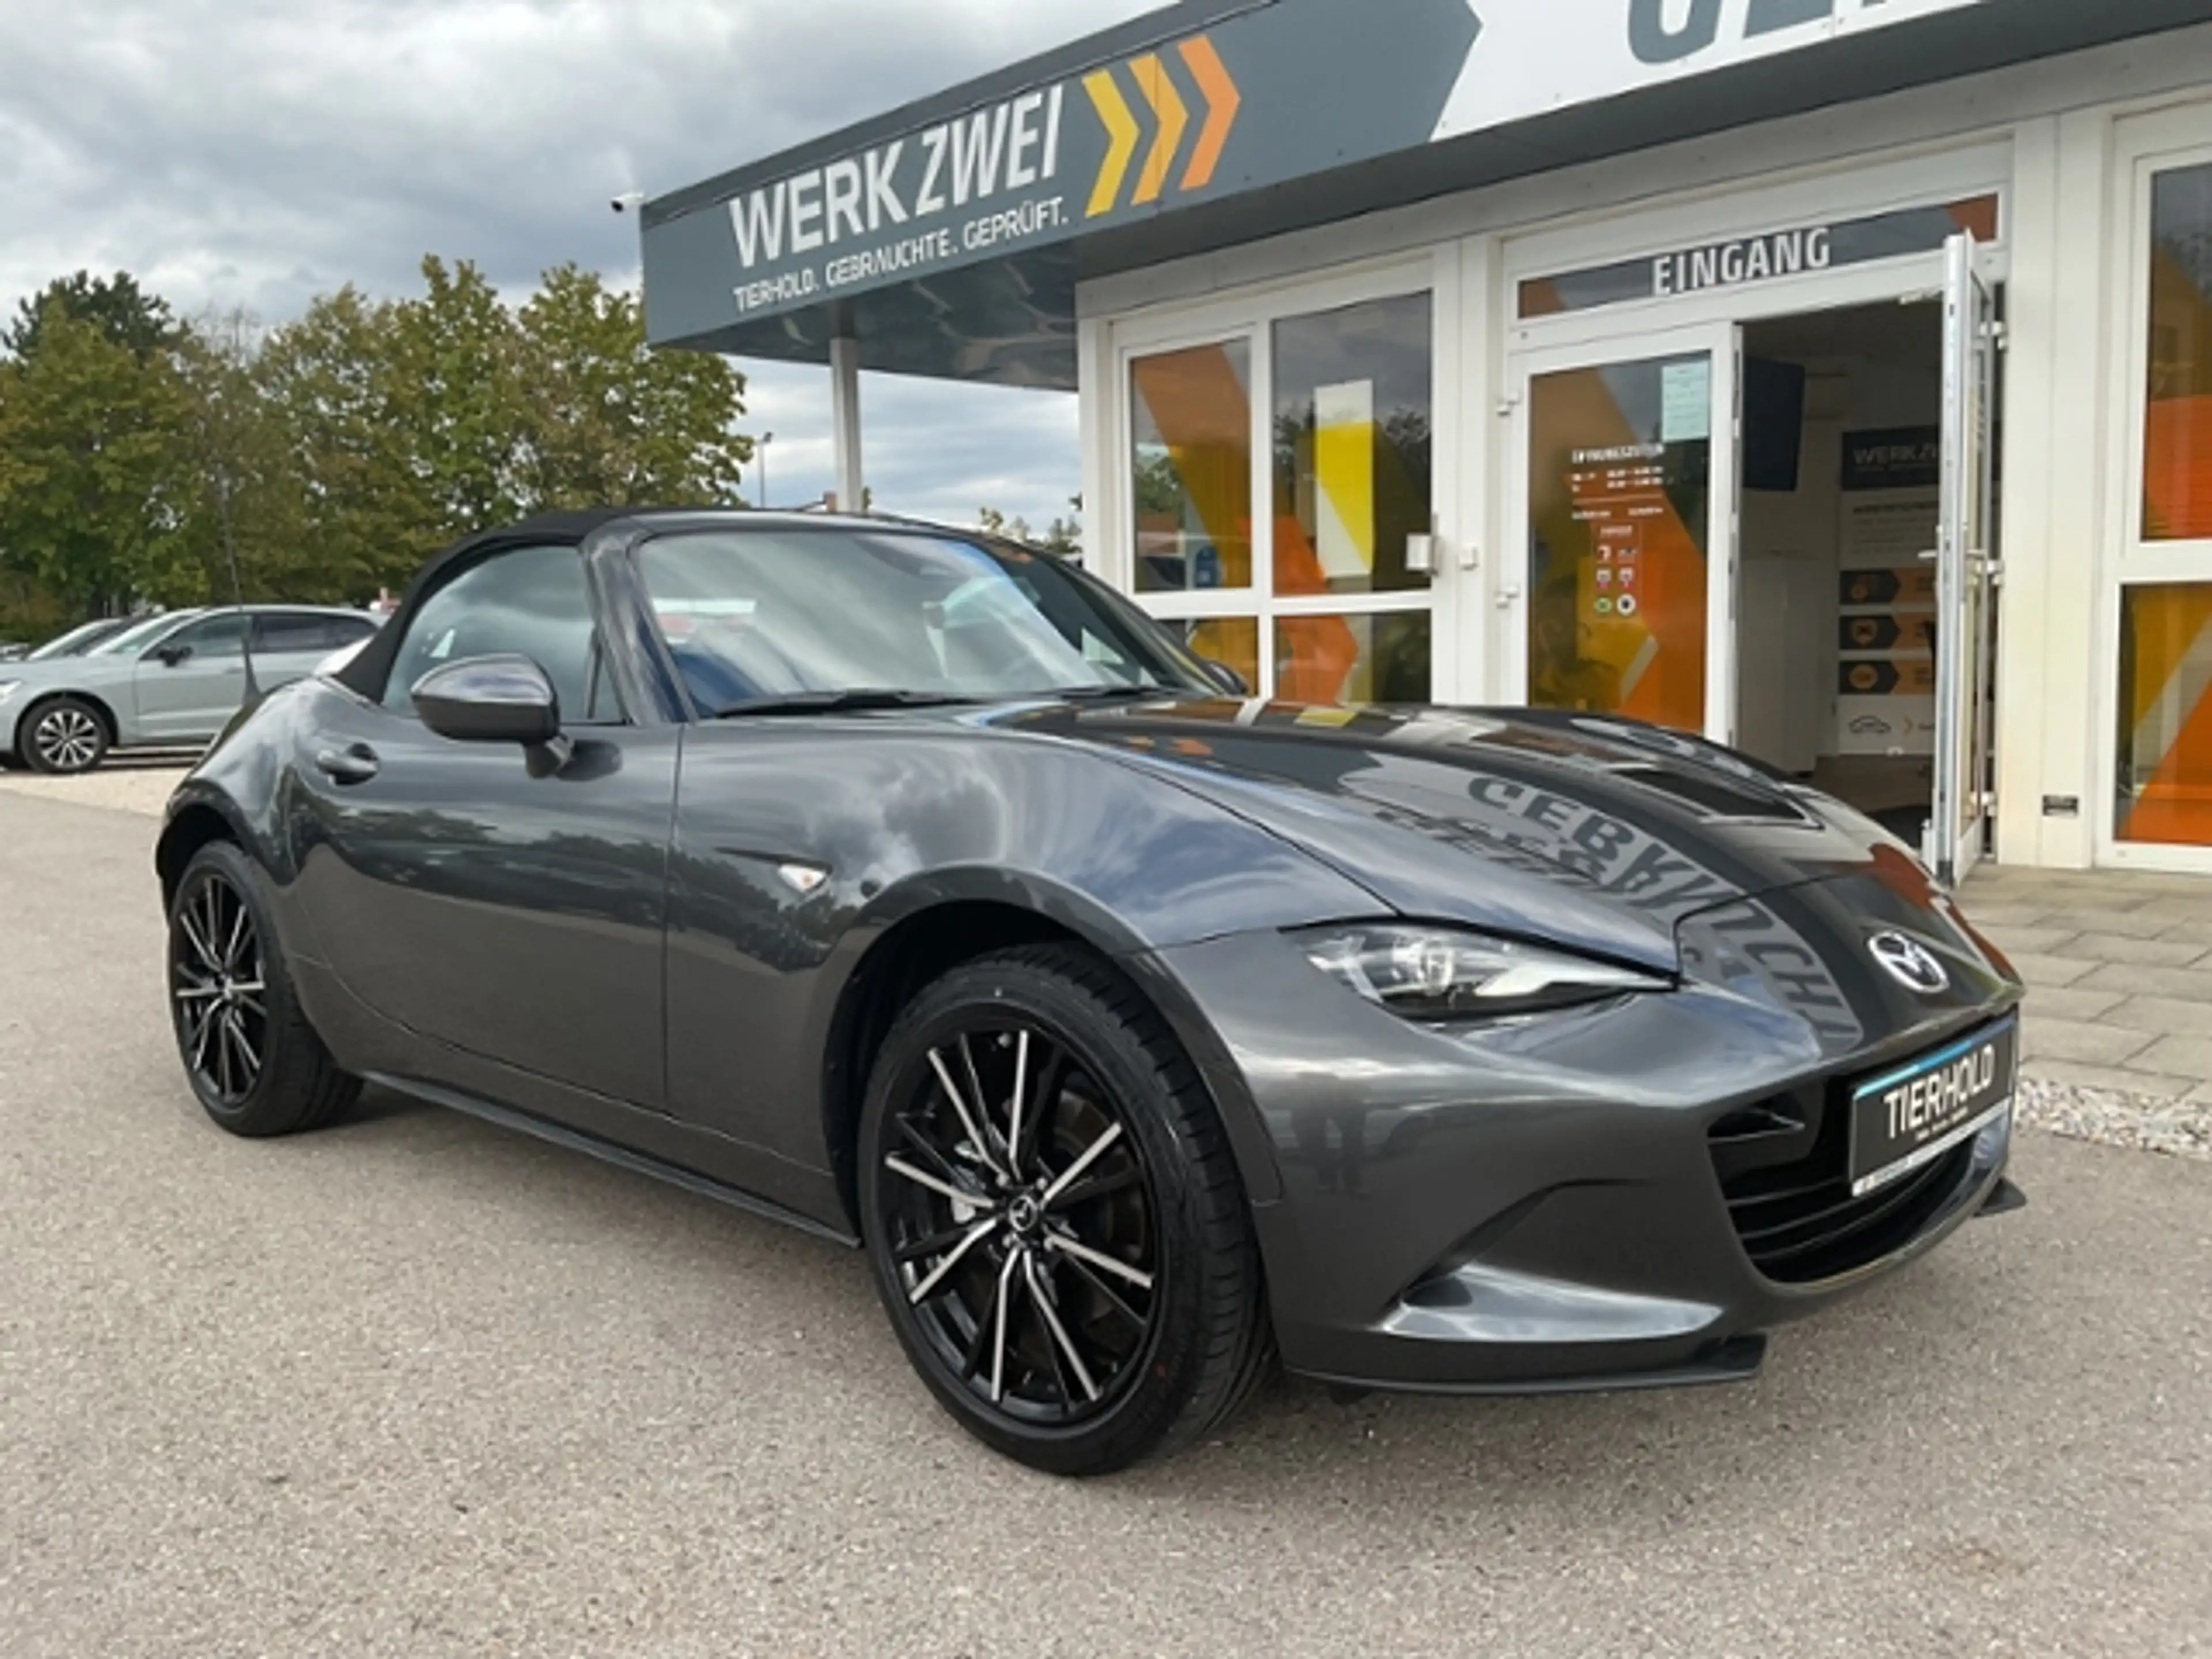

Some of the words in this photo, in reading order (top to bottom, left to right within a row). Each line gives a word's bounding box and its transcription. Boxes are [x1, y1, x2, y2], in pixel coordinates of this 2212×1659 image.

[729, 140, 909, 268] WERK
[914, 84, 1063, 218] ZWEI
[825, 228, 958, 288] GEBRAUCHTE.
[963, 196, 1069, 251] GEPRÜFT.
[1652, 228, 1831, 296] EINGANG
[1883, 1043, 1995, 1139] TIERHOLD
